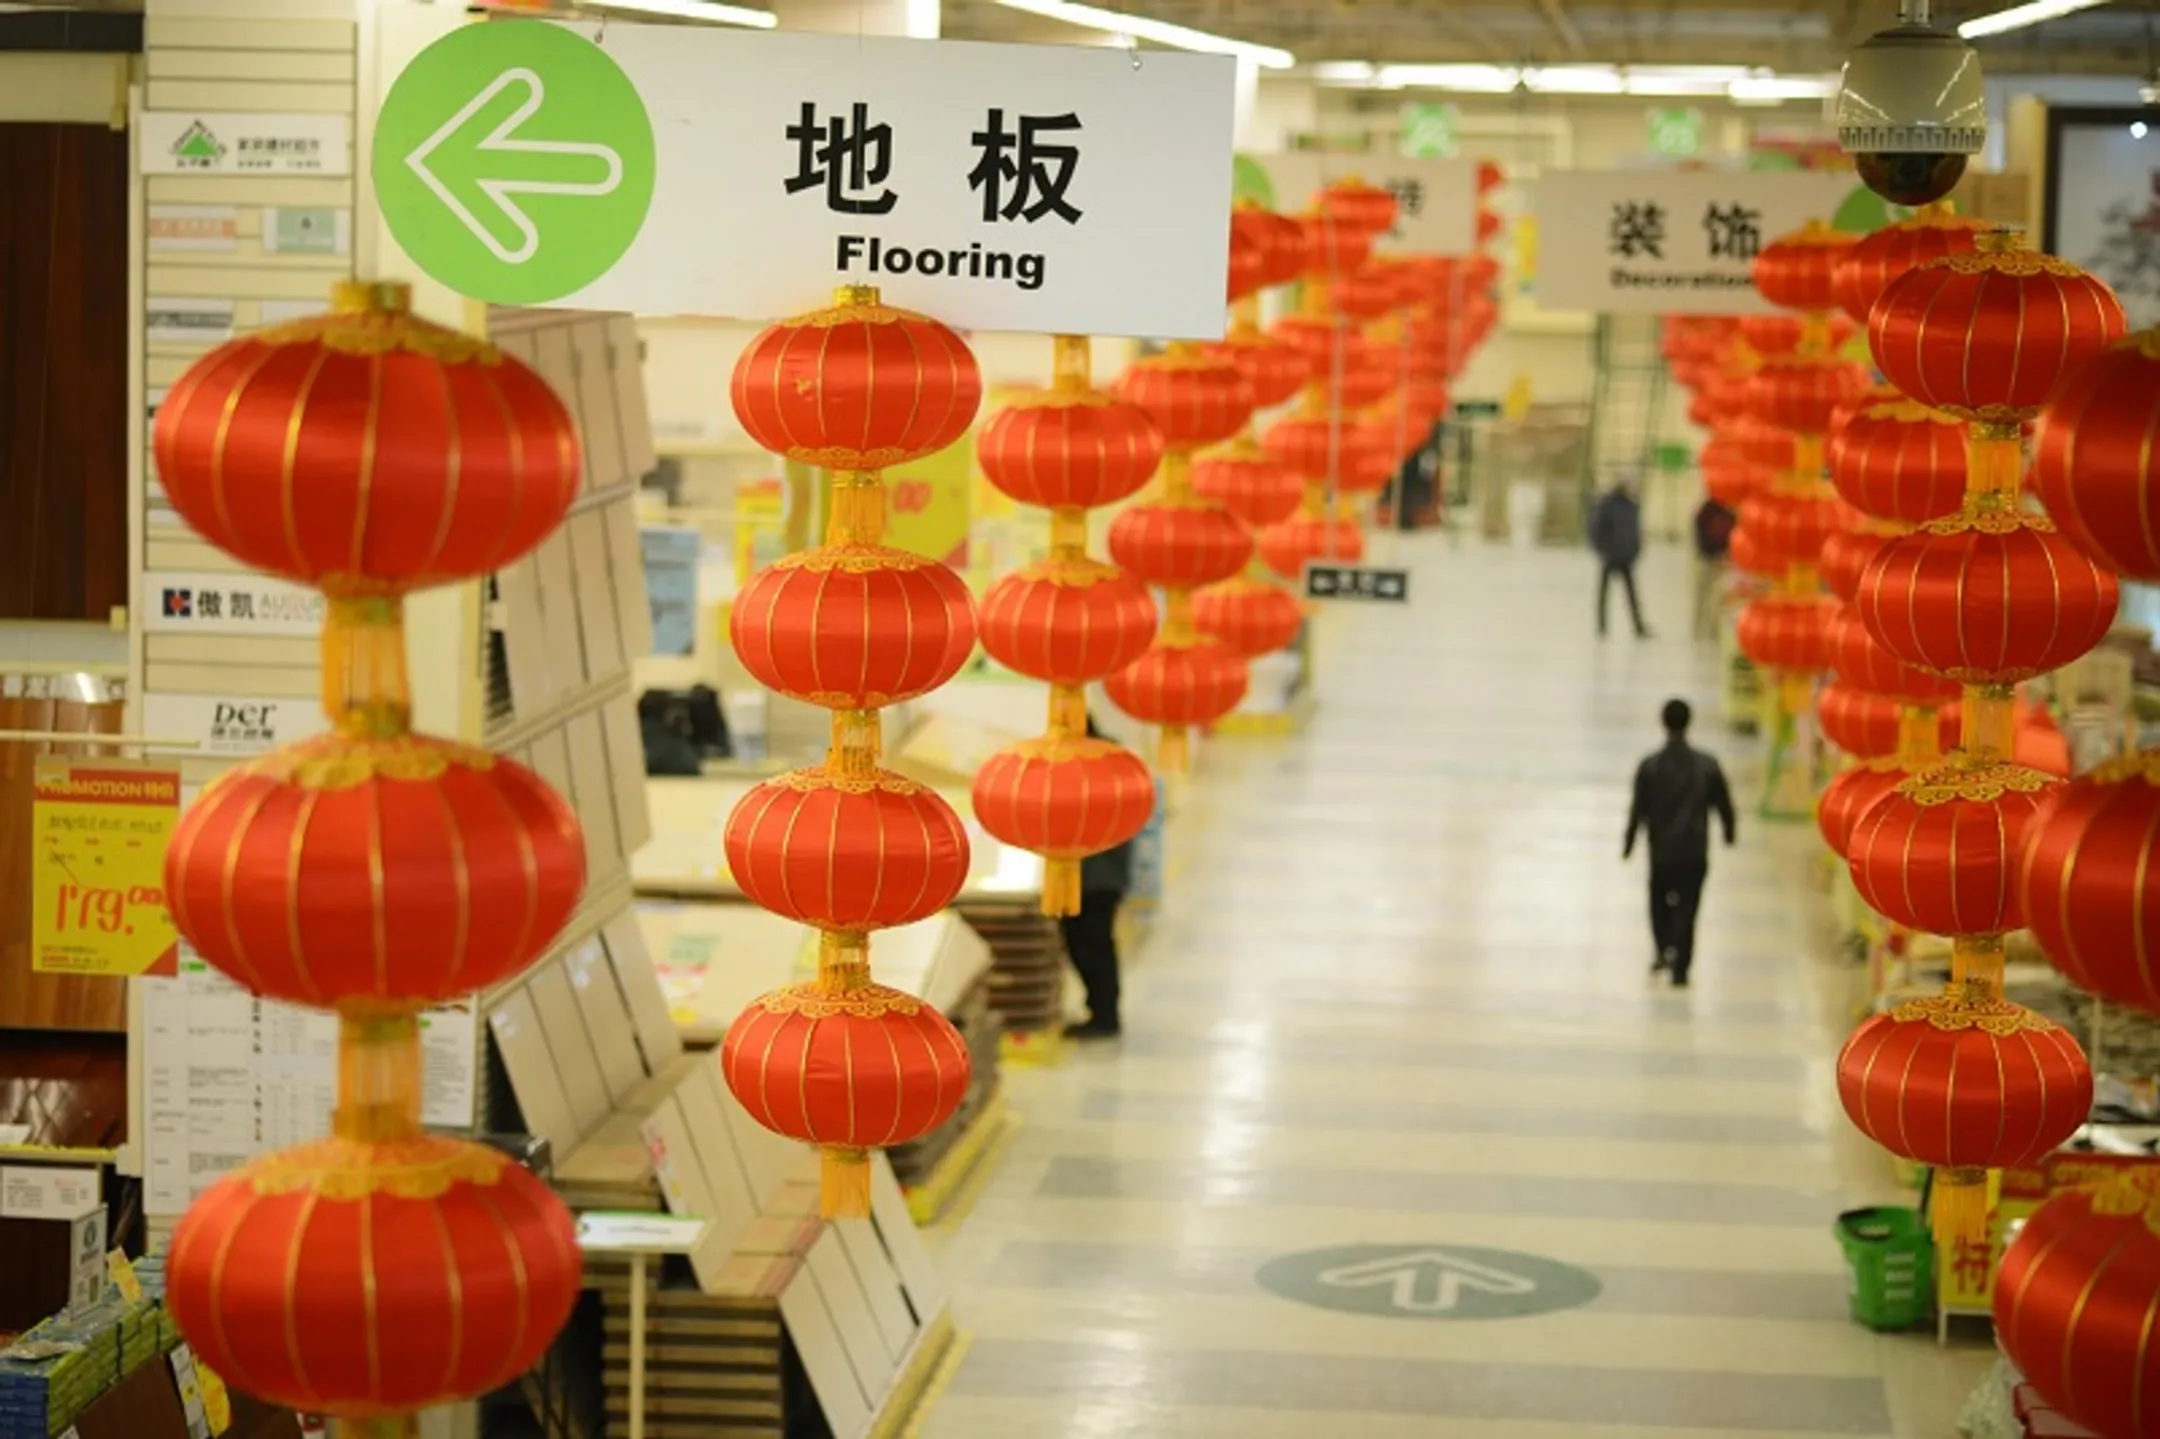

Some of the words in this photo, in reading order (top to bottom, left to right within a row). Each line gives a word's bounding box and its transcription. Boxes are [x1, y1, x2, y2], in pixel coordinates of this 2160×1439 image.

[783, 102, 1084, 225] 地板
[1609, 201, 1762, 261] 装饰
[836, 235, 1046, 290] Flooring
